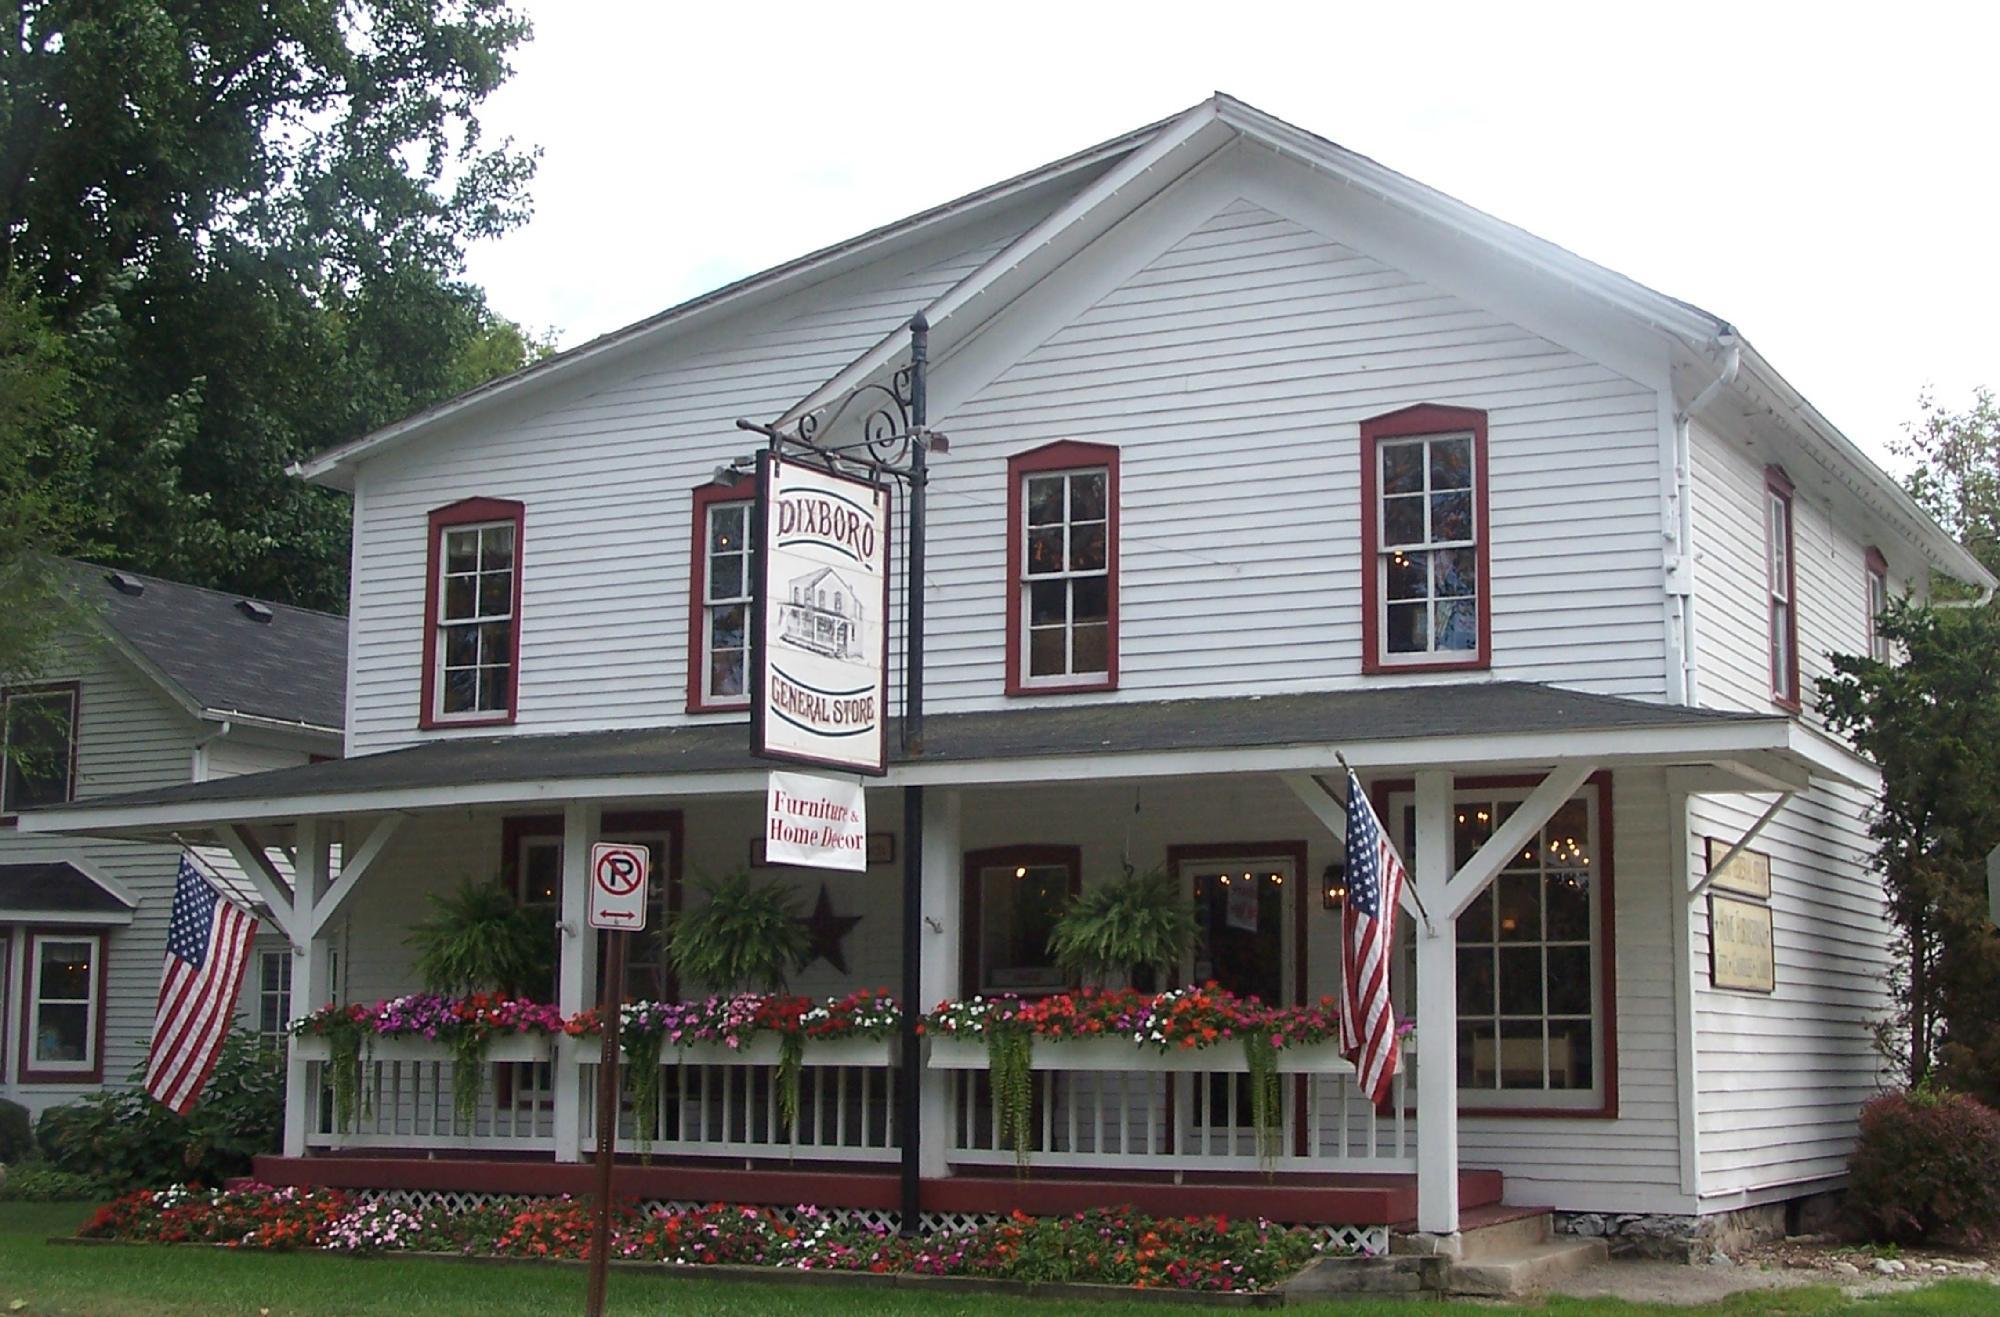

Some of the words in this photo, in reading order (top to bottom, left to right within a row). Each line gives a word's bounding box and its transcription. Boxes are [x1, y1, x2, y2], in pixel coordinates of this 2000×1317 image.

[776, 499, 874, 561] DIXBORO
[771, 675, 830, 724] GENERAL
[833, 696, 875, 725] STORE
[774, 790, 848, 822] Furniture
[850, 810, 860, 823] &
[770, 818, 818, 846] Home
[821, 826, 864, 850] Decor
